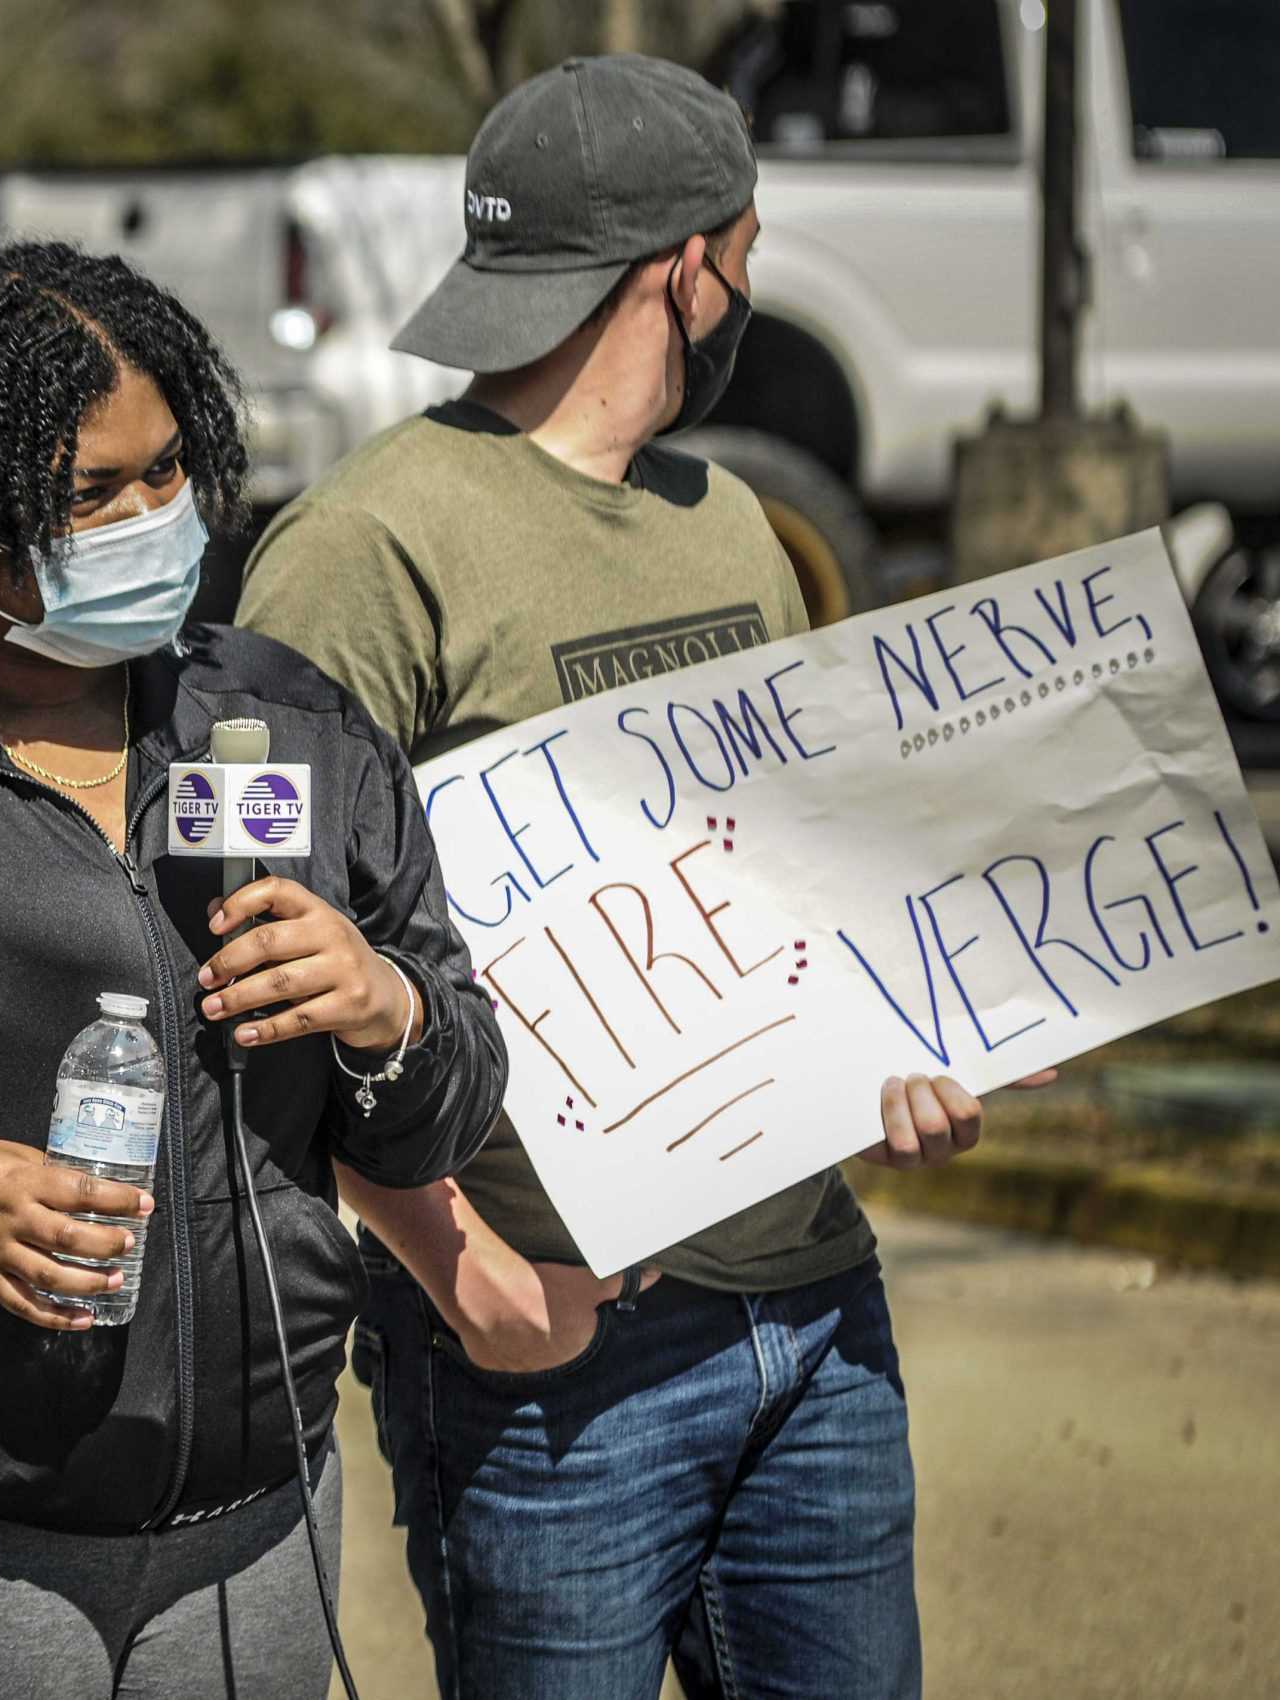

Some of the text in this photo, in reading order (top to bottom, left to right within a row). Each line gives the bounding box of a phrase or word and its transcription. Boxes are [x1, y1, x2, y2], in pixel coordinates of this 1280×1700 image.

[172, 801, 219, 815] TIGER TV
[236, 802, 304, 815] TIGER TV
[426, 566, 1154, 928] GET SOME NERVE,
[481, 840, 785, 1109] FIRE
[837, 811, 1271, 1068] VERGE!
